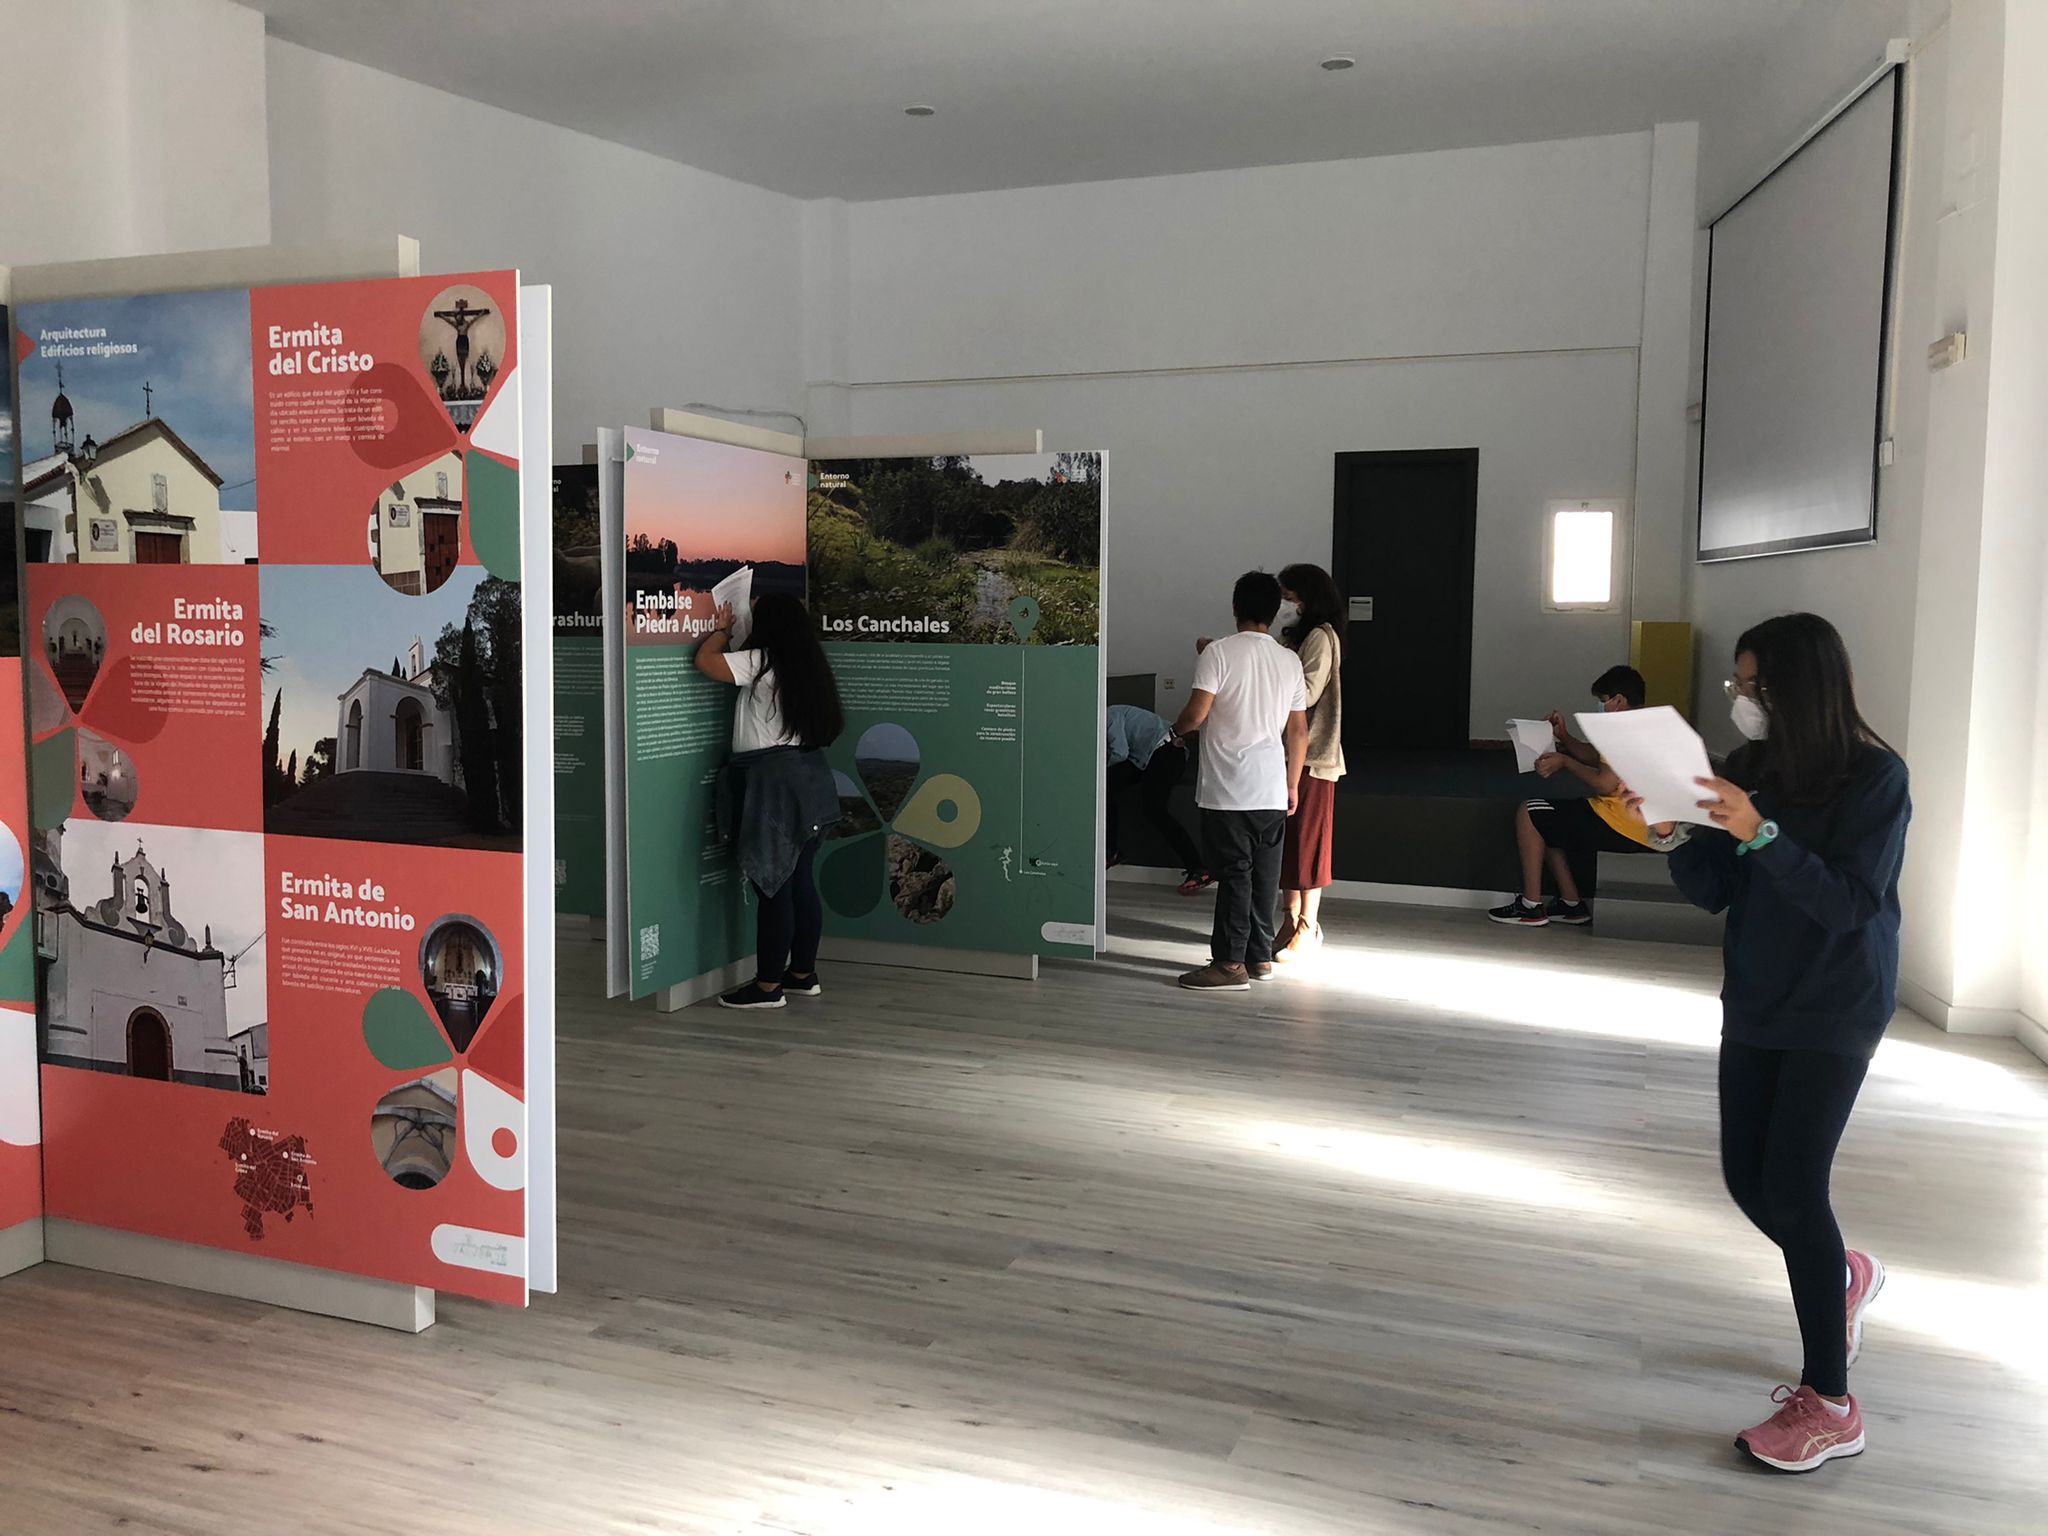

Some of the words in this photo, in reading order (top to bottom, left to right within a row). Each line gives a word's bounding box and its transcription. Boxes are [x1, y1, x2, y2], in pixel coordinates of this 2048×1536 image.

[40, 327, 106, 342] Arquitectura
[269, 321, 342, 348] Ermita
[41, 344, 85, 358] Edificios
[87, 342, 138, 358] religiosos
[269, 351, 302, 375] del
[307, 348, 374, 373] Cristo
[820, 472, 850, 480] Entorno
[820, 480, 847, 489] natural
[174, 597, 243, 620] Ermita
[636, 590, 692, 609] Embalse
[131, 622, 160, 643] del
[167, 622, 244, 646] Rosario
[636, 613, 679, 634] Piedra
[682, 614, 717, 638] Agud
[822, 615, 853, 631] Los
[857, 615, 950, 633] Canchales
[281, 871, 353, 898] Ermita
[358, 878, 385, 902] de
[281, 897, 319, 921] San
[324, 901, 415, 931] Antonio
